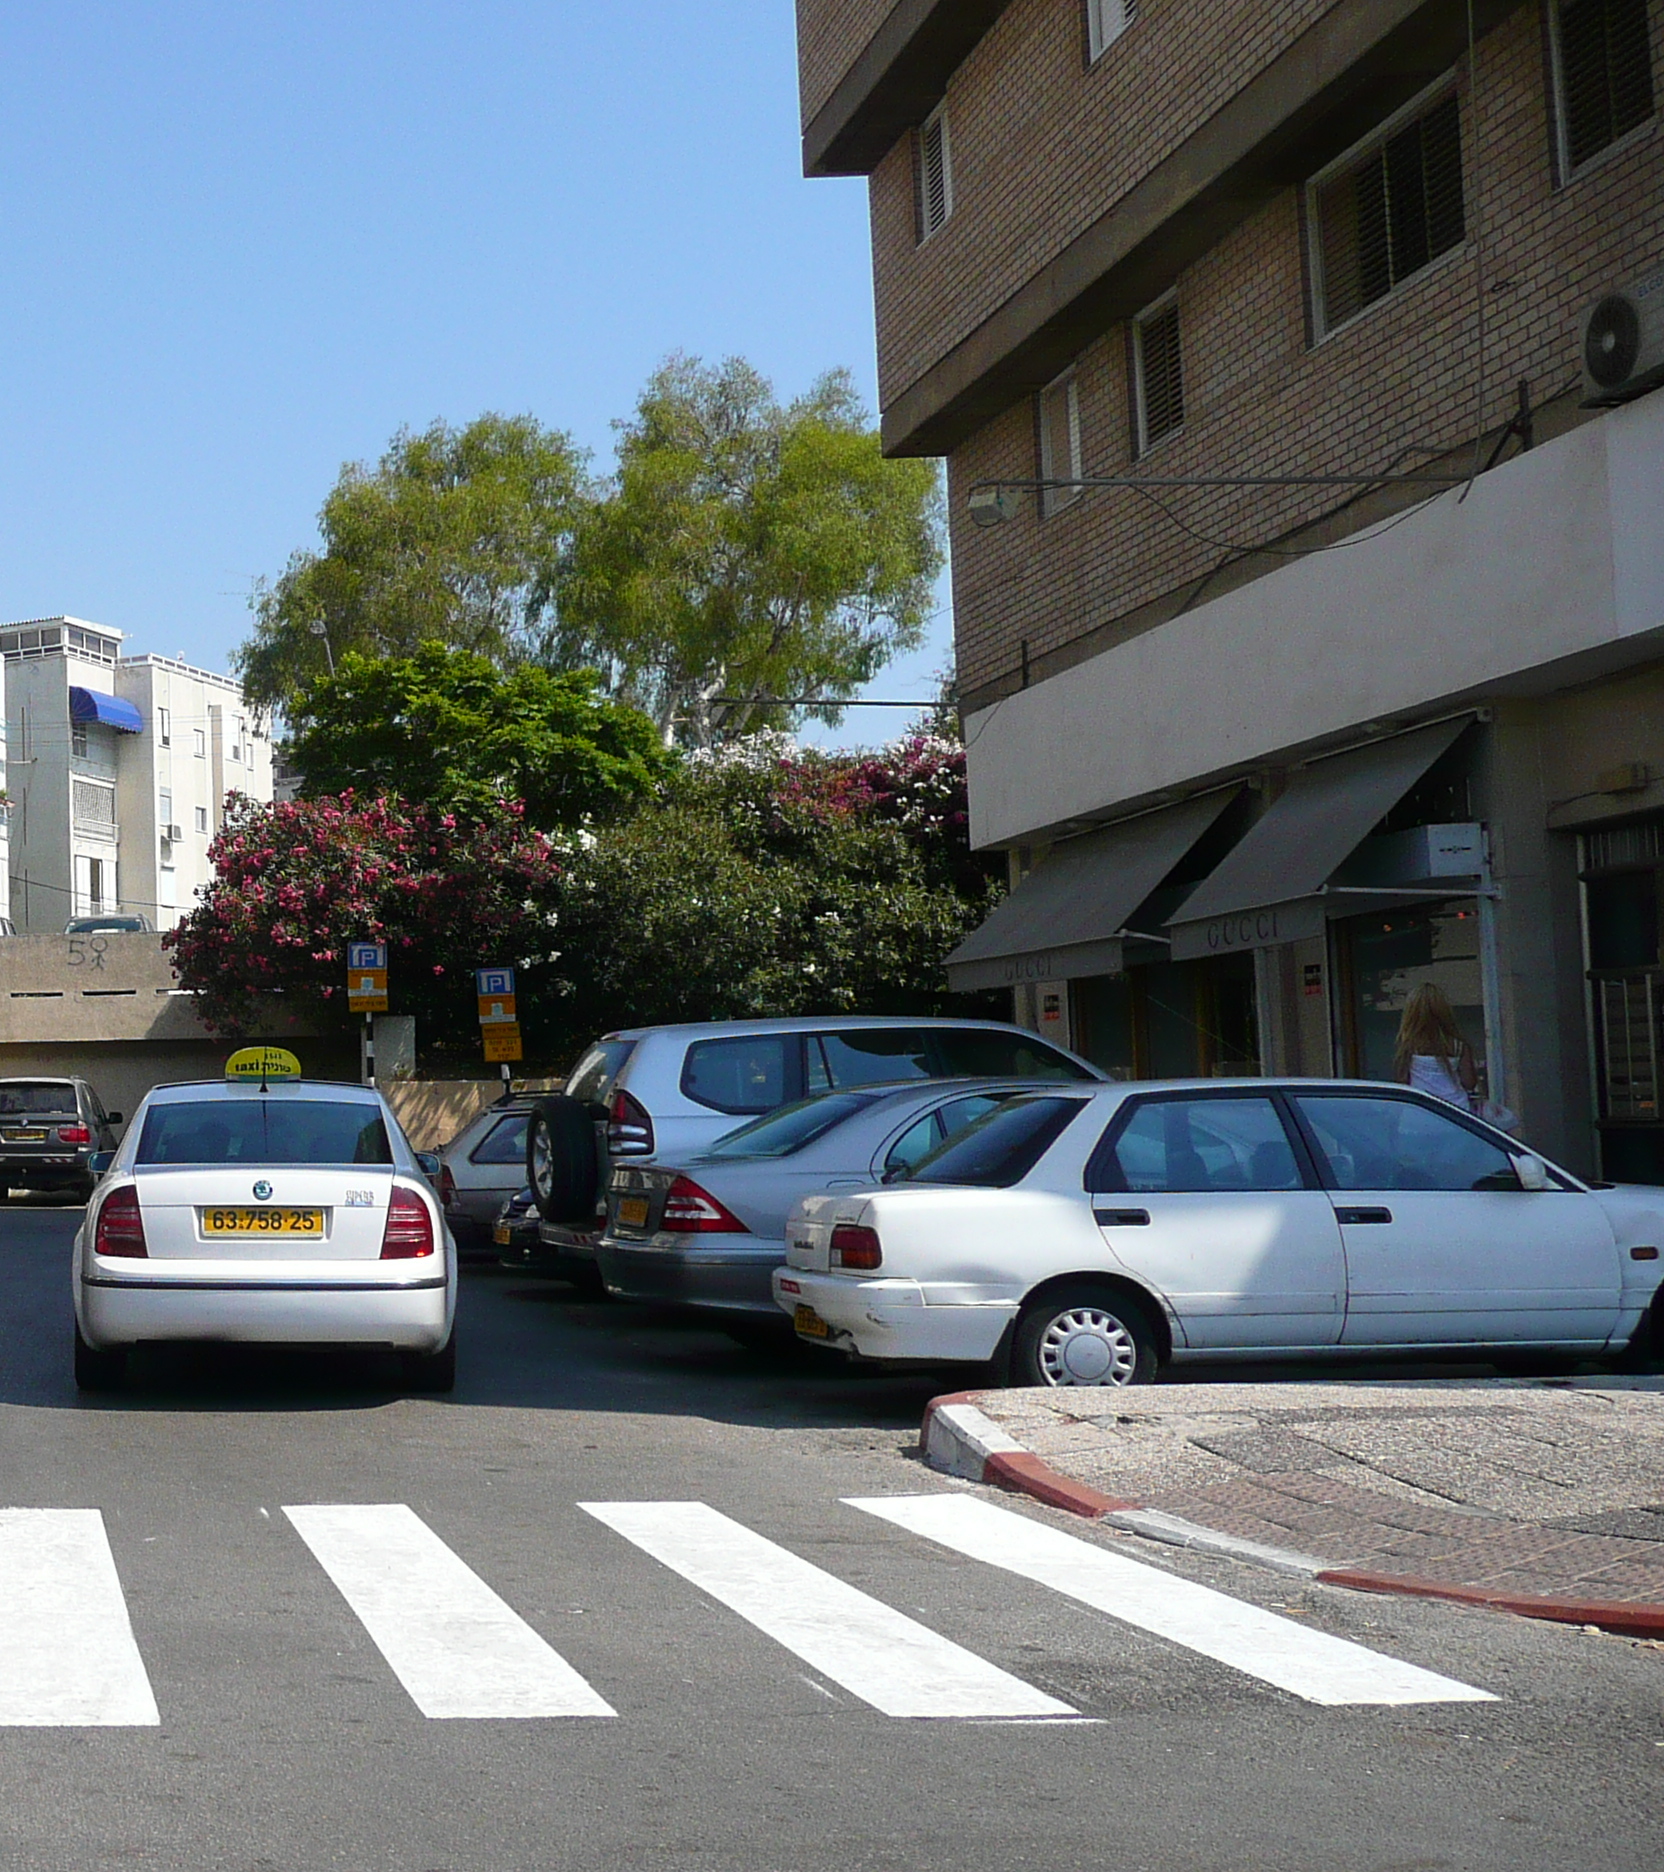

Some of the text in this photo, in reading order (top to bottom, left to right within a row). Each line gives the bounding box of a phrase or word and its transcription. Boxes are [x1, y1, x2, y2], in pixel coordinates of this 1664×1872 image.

[1207, 912, 1279, 949] GUCCI
[361, 951, 375, 966] P
[1005, 954, 1052, 981] GUCCI
[489, 977, 502, 992] P
[235, 1058, 260, 1072] taxi
